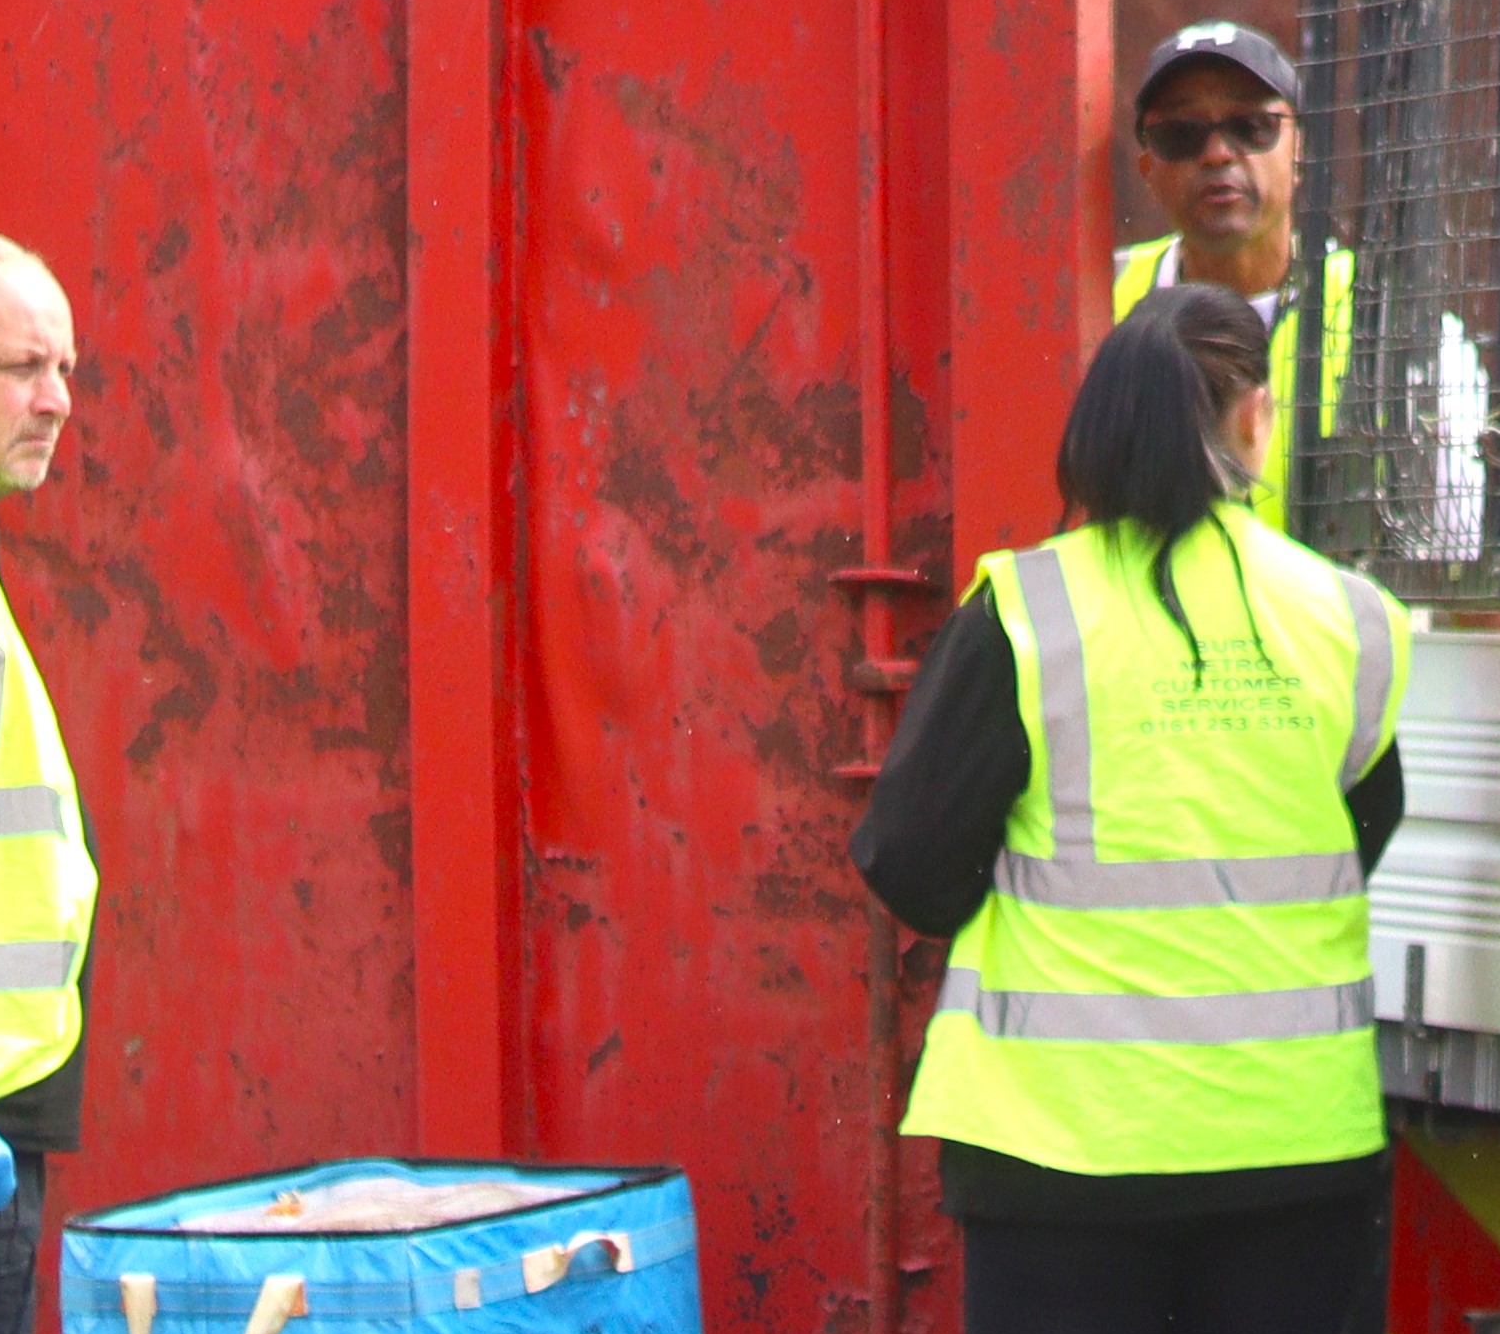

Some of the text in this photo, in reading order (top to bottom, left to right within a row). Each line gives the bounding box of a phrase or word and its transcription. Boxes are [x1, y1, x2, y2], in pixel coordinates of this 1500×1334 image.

[1197, 639, 1263, 654] BURY
[1161, 696, 1293, 713] SERVICES
[1140, 716, 1316, 734] 0161 253 5353
